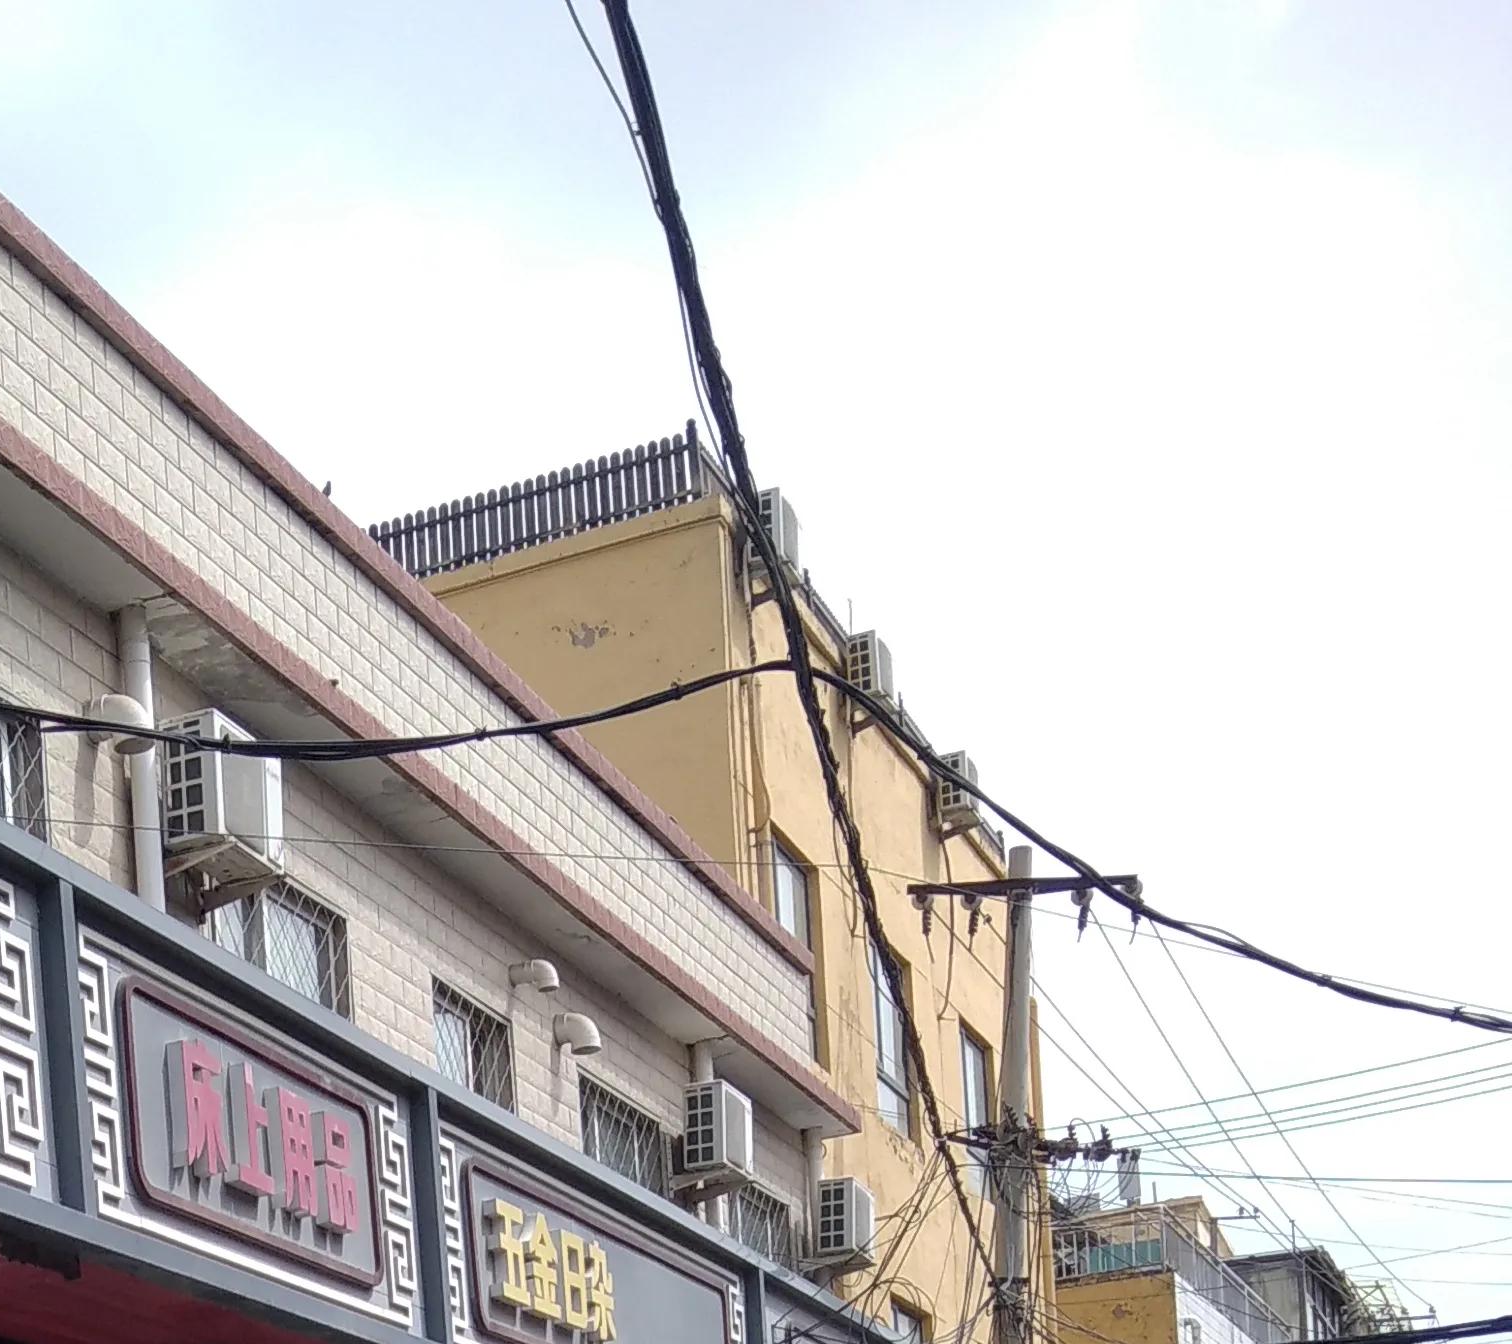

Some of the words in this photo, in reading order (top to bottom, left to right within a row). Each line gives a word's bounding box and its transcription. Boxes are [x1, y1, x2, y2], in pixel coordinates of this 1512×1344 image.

[168, 1039, 360, 1234] 床上用品
[485, 1198, 617, 1343] 五金日杂
